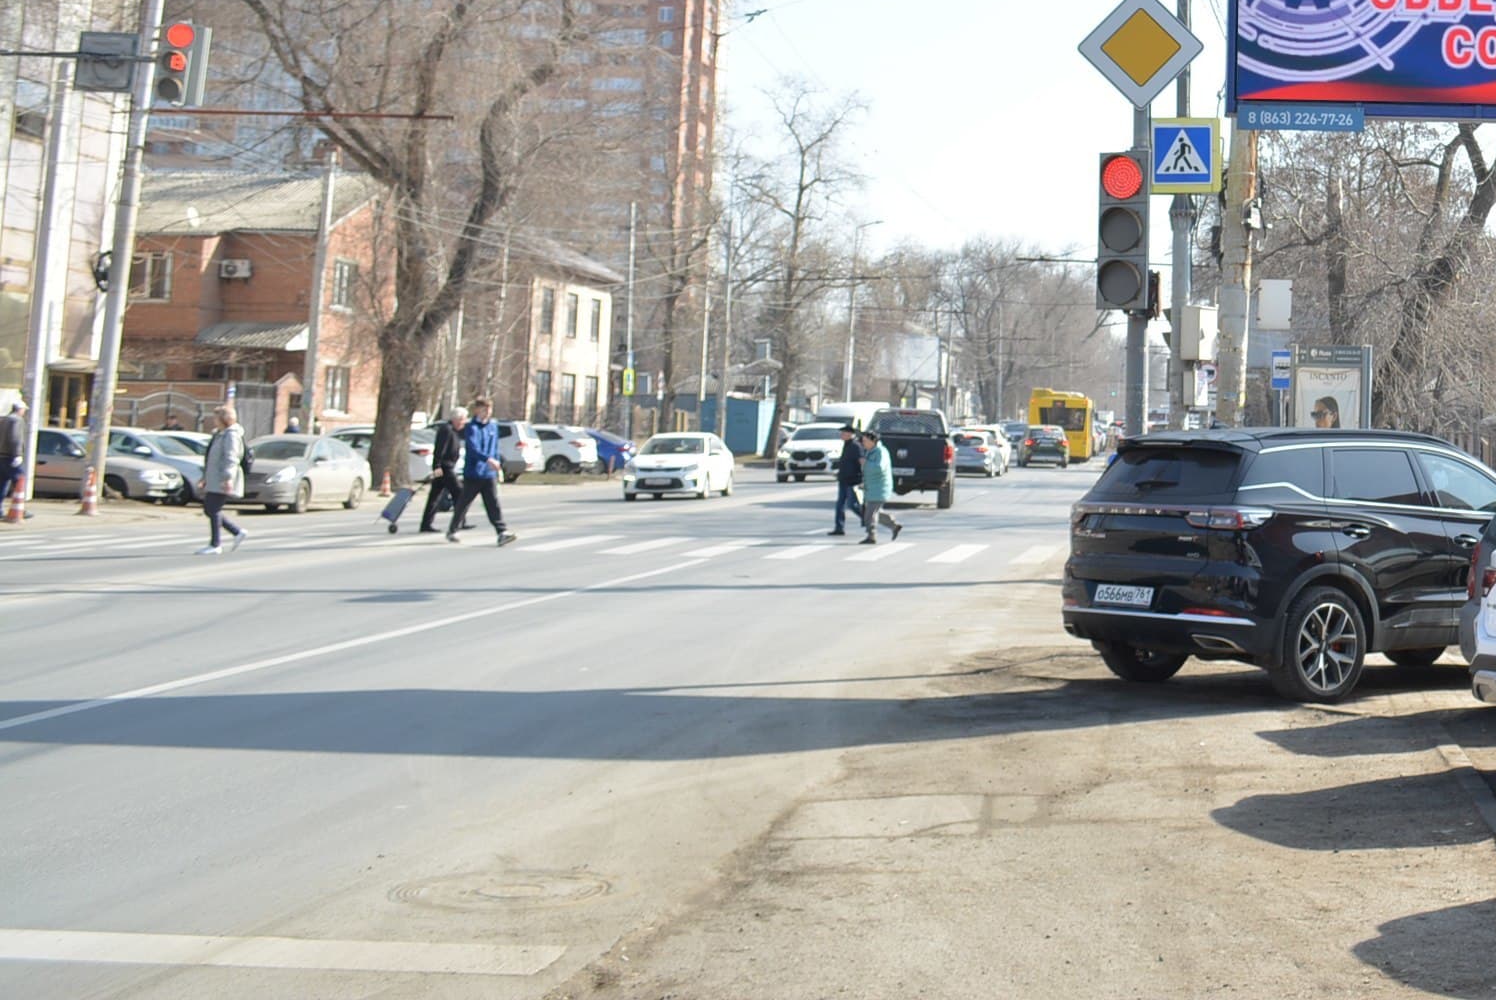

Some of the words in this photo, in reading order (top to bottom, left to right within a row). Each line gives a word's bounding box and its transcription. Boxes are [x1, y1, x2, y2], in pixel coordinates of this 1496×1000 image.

[1247, 111, 1257, 125] 8
[1260, 110, 1291, 126] (863)
[1294, 111, 1354, 127] 226-77-26
